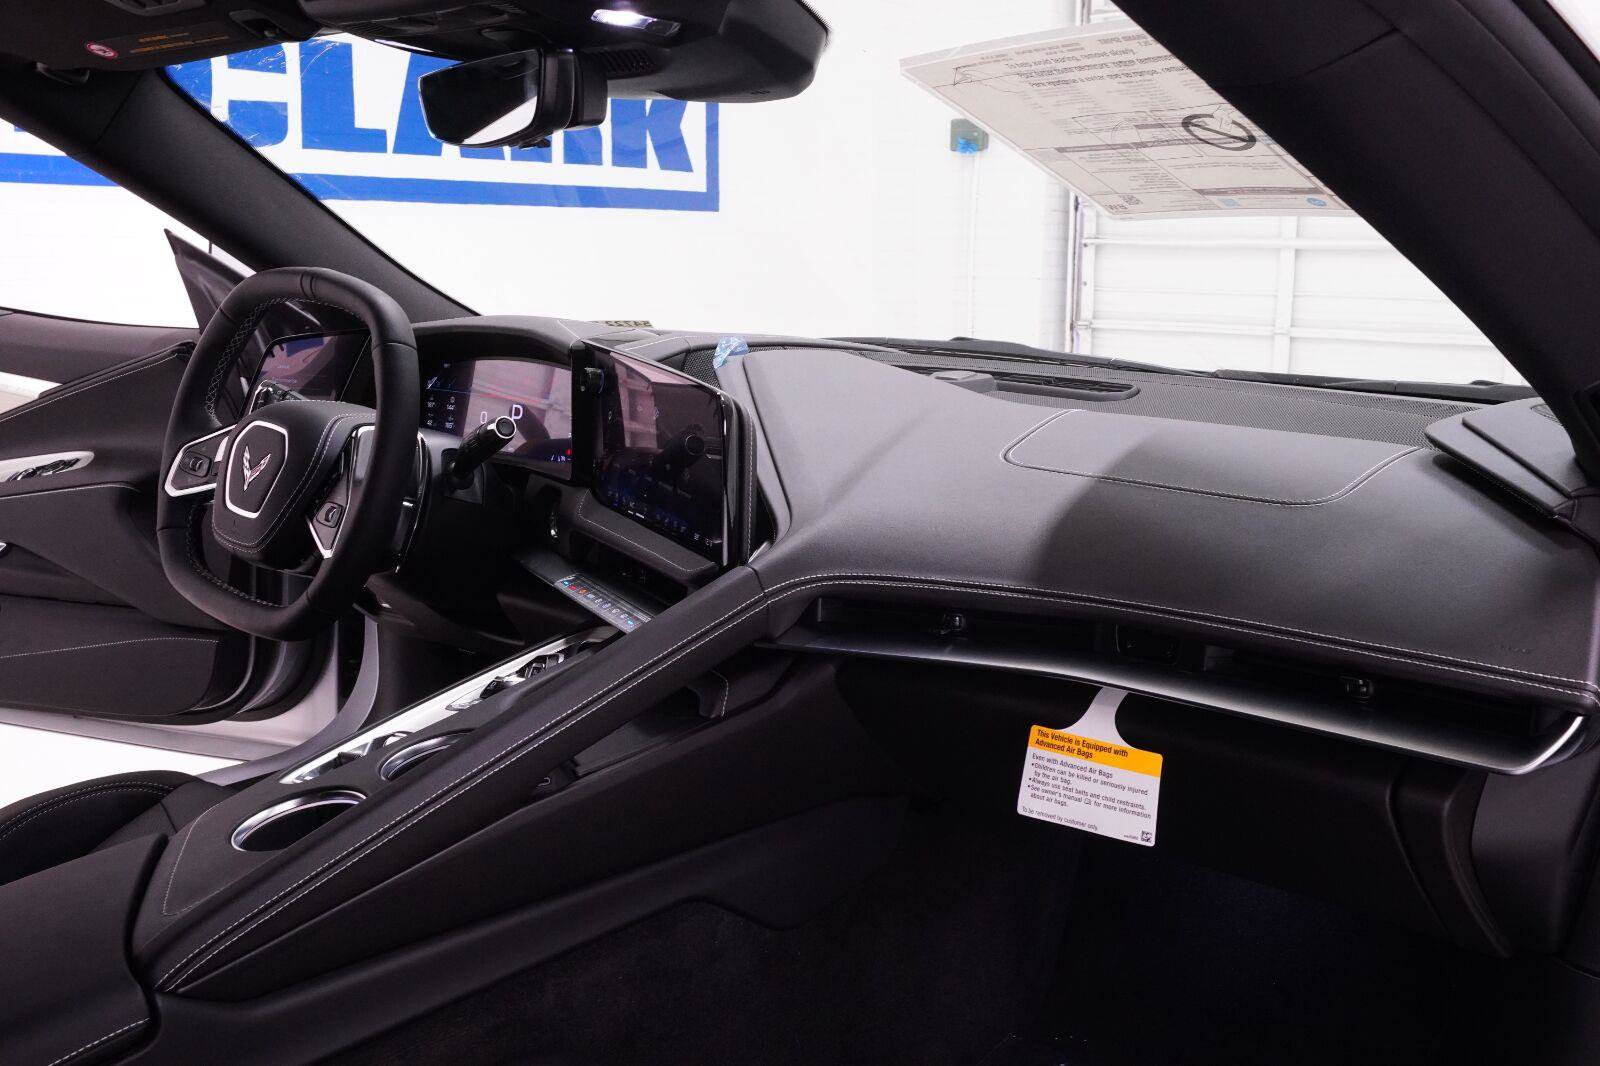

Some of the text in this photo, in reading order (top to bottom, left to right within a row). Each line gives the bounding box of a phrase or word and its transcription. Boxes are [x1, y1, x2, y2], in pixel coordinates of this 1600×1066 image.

[168, 36, 693, 173] CLK
[1035, 739, 1093, 759] Advanced Air Bags
[1037, 729, 1129, 758] This Vehicle is Equipped with
[1046, 757, 1059, 765] with
[1060, 760, 1087, 772] Advanced
[1098, 769, 1113, 779] Bags
[1100, 780, 1126, 791] seriously
[1062, 793, 1083, 803] manual
[1103, 803, 1118, 811] more
[1118, 807, 1151, 820] information
[1089, 792, 1100, 800] and
[1101, 795, 1116, 803] child
